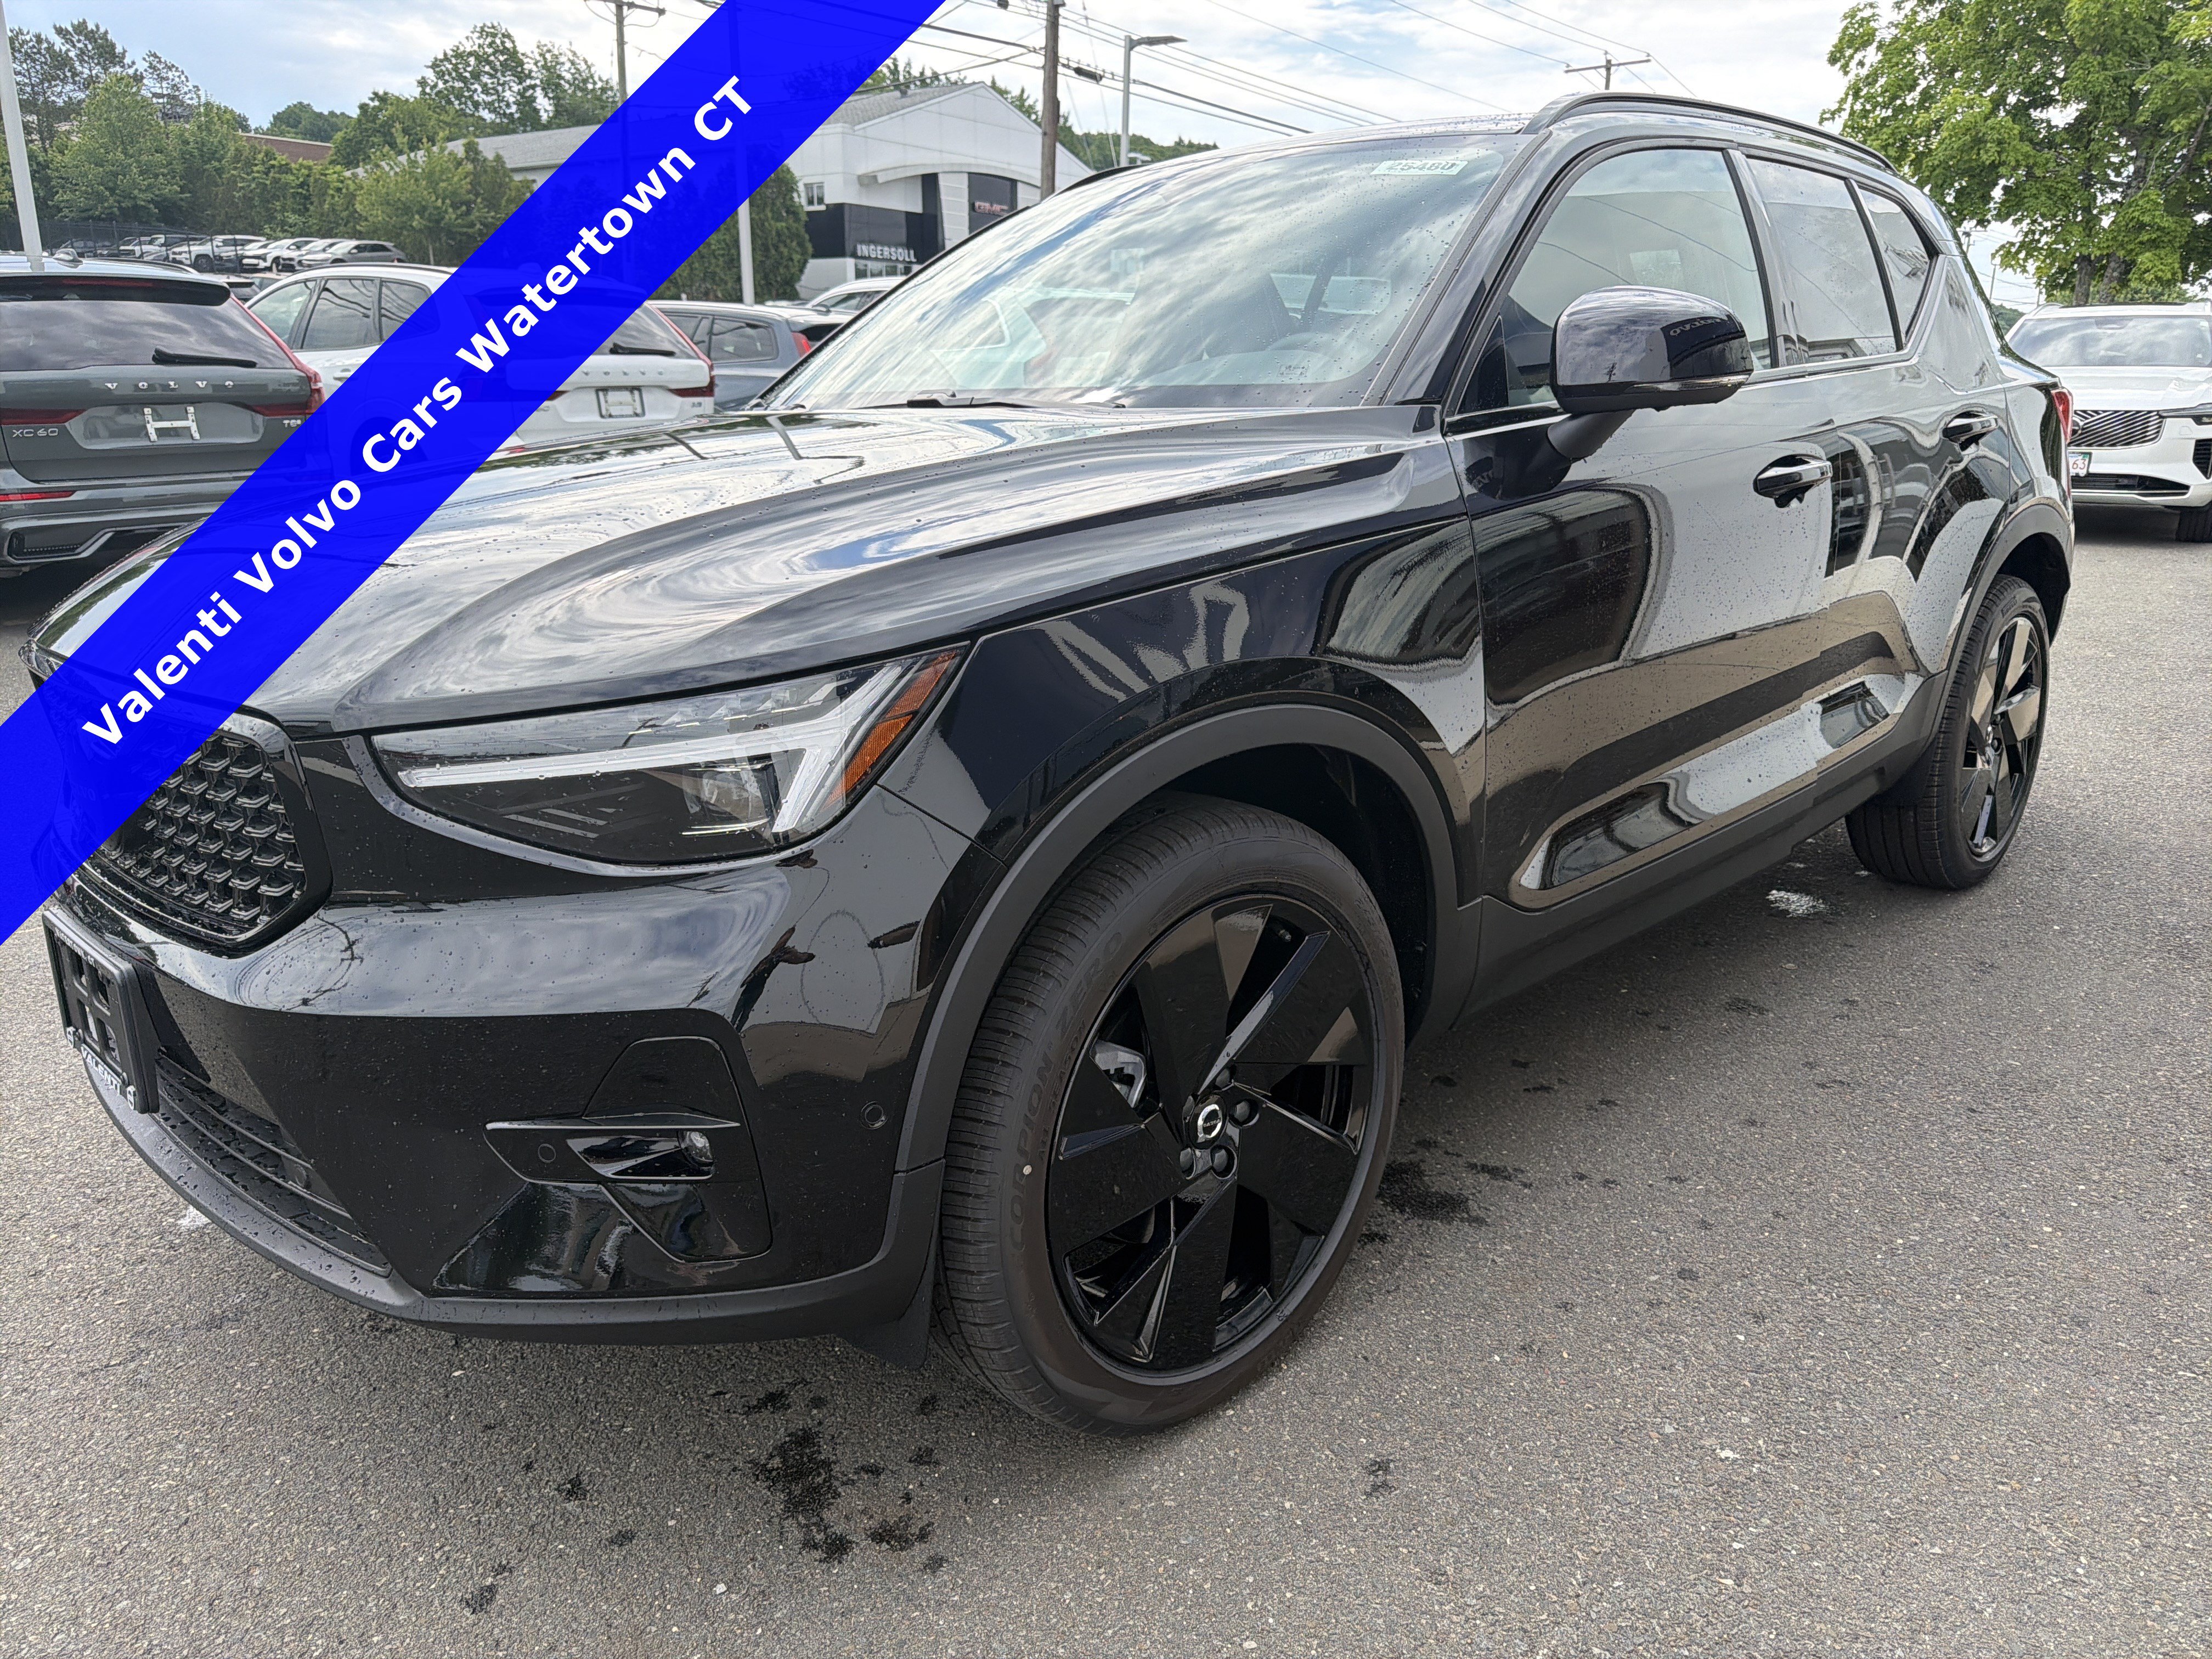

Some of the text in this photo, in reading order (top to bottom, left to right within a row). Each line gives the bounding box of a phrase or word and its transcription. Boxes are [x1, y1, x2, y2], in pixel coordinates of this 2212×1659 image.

[974, 201, 1009, 216] GMC
[856, 243, 917, 262] INGERSOLL
[104, 380, 234, 390] VOLVO
[12, 428, 59, 438] XC60
[2072, 459, 2086, 470] 63
[80, 1046, 121, 1097] VALENTI
